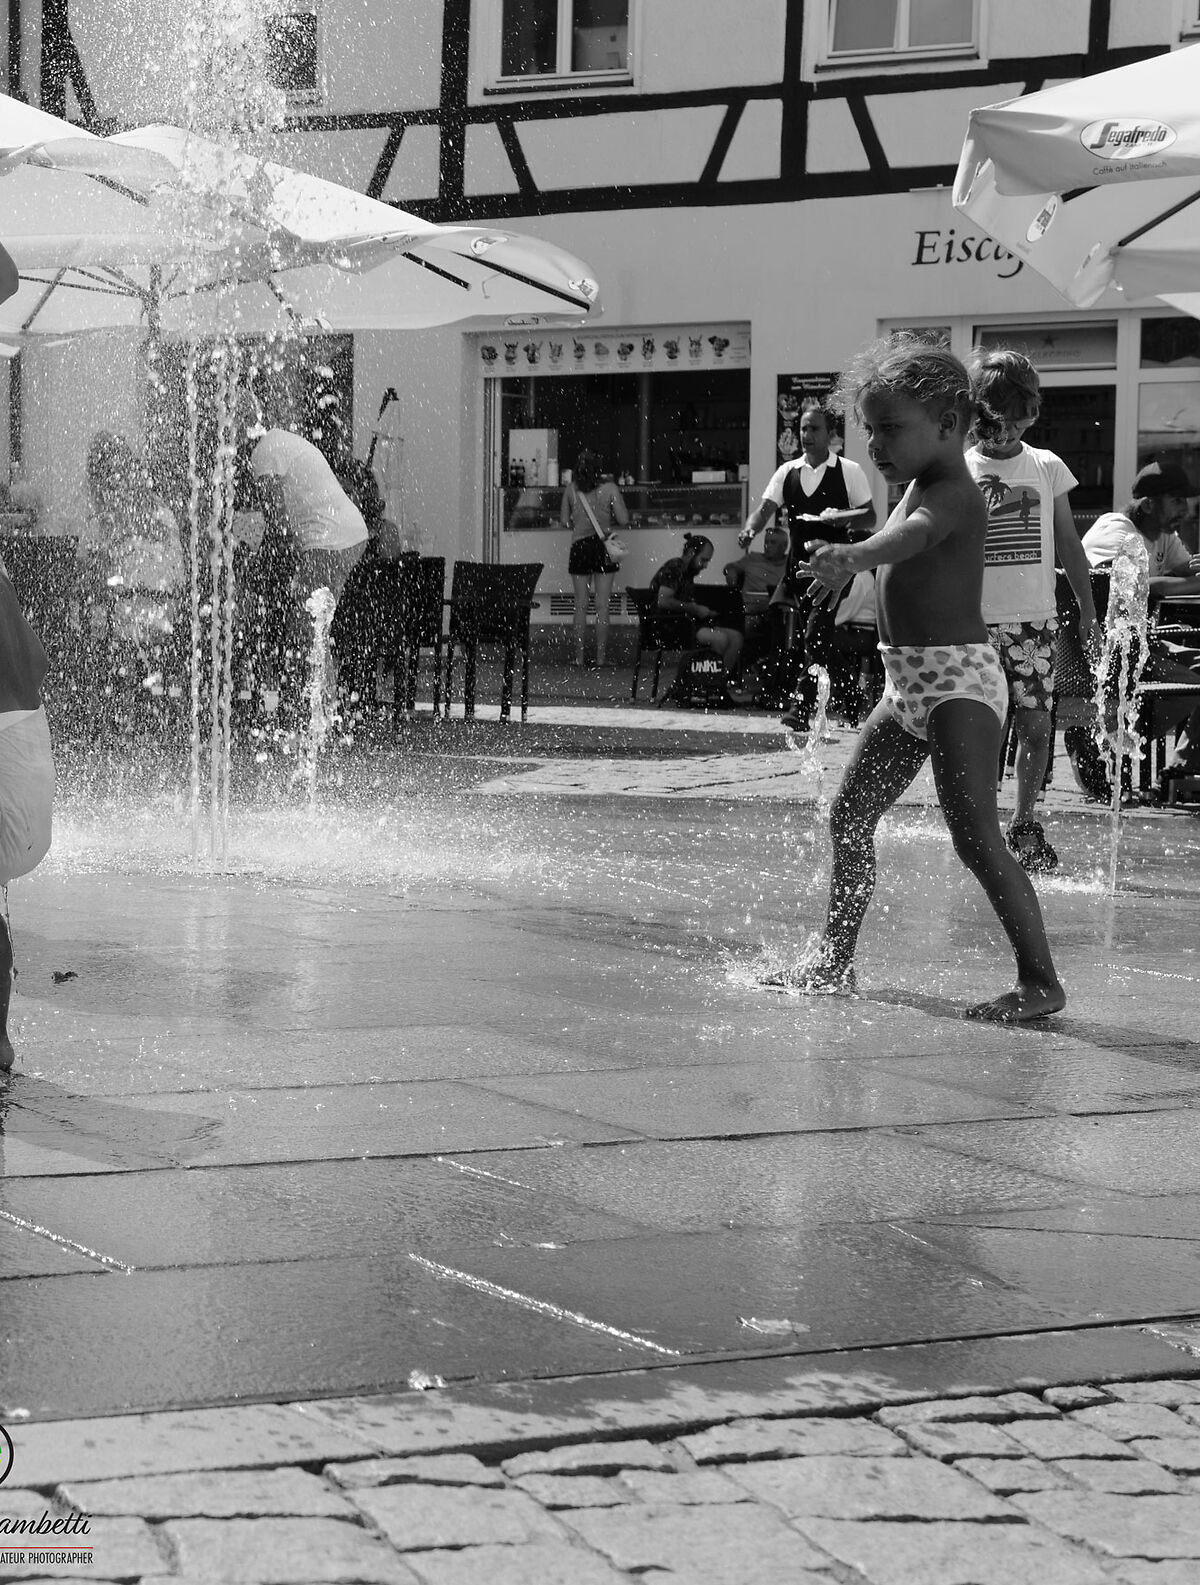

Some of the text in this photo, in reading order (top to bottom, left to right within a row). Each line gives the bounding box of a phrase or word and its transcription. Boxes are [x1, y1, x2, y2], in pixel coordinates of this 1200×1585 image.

[1090, 122, 1168, 149] Segafredo
[984, 550, 1038, 562] urfers beach
